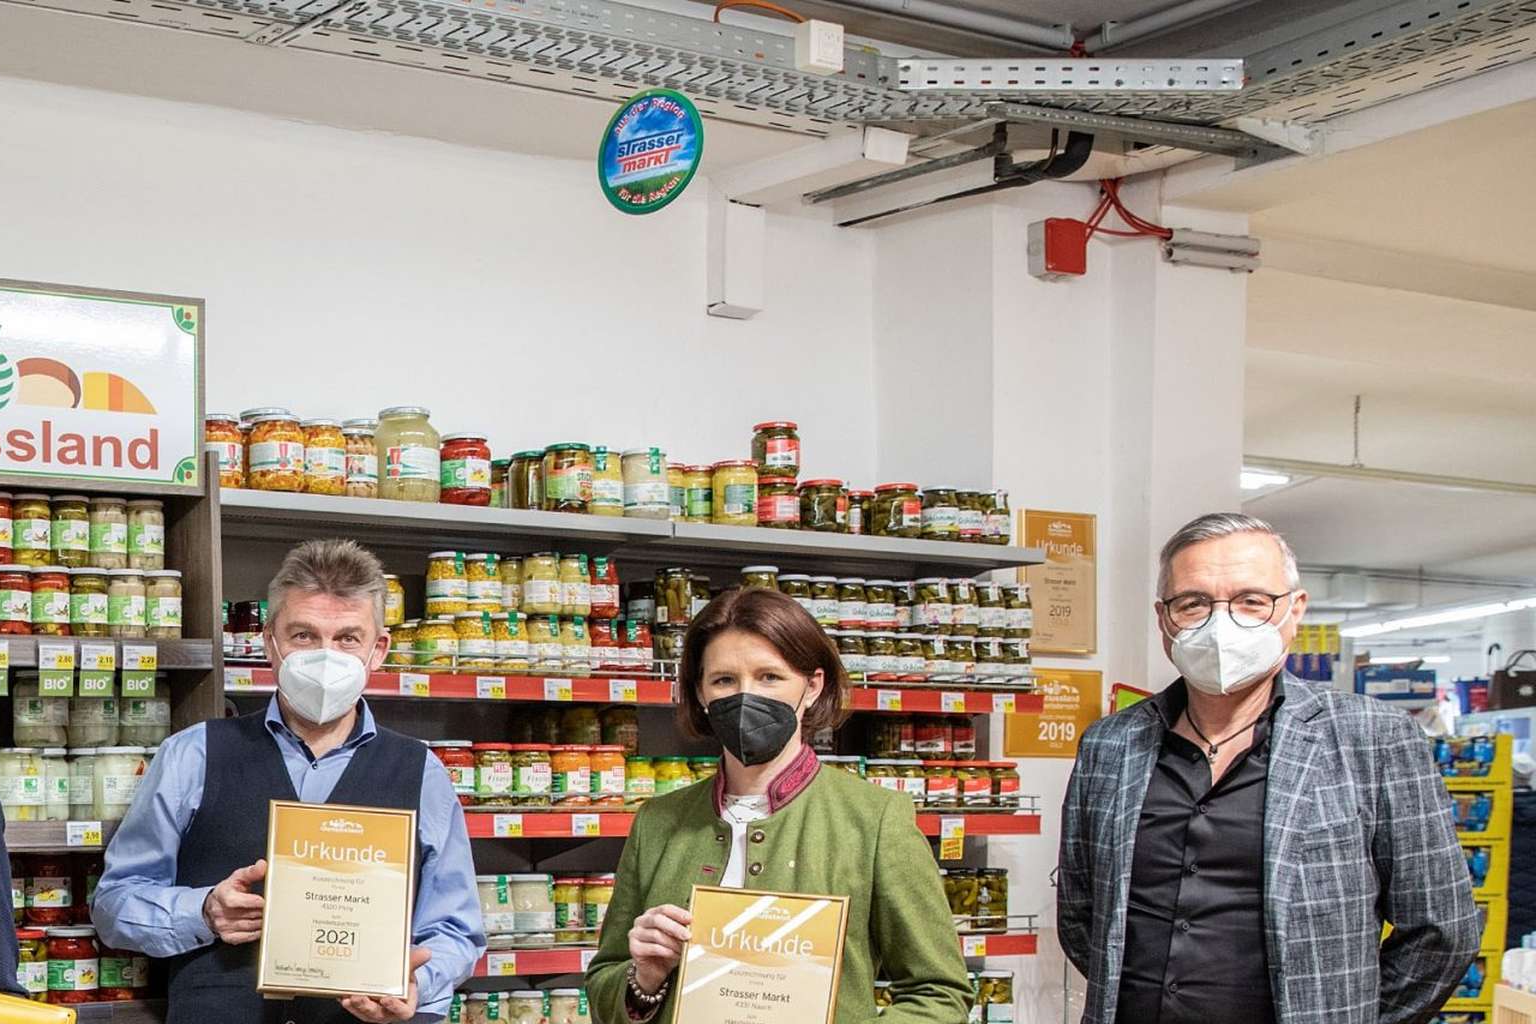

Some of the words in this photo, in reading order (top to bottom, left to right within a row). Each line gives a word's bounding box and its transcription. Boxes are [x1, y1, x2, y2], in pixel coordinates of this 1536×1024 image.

[1049, 605, 1072, 618] 2019
[44, 678, 67, 690] BIO
[84, 678, 106, 690] BIO
[126, 679, 148, 690] BIO
[1038, 722, 1075, 741] 2019
[293, 840, 387, 863] Urkunde
[305, 892, 342, 902] Strasser
[344, 895, 370, 904] Markt
[315, 929, 355, 945] 2021
[711, 927, 813, 956] Urkunde
[317, 947, 352, 957] GOLD
[719, 987, 759, 1001] Strasser
[762, 992, 790, 1003] Markt
